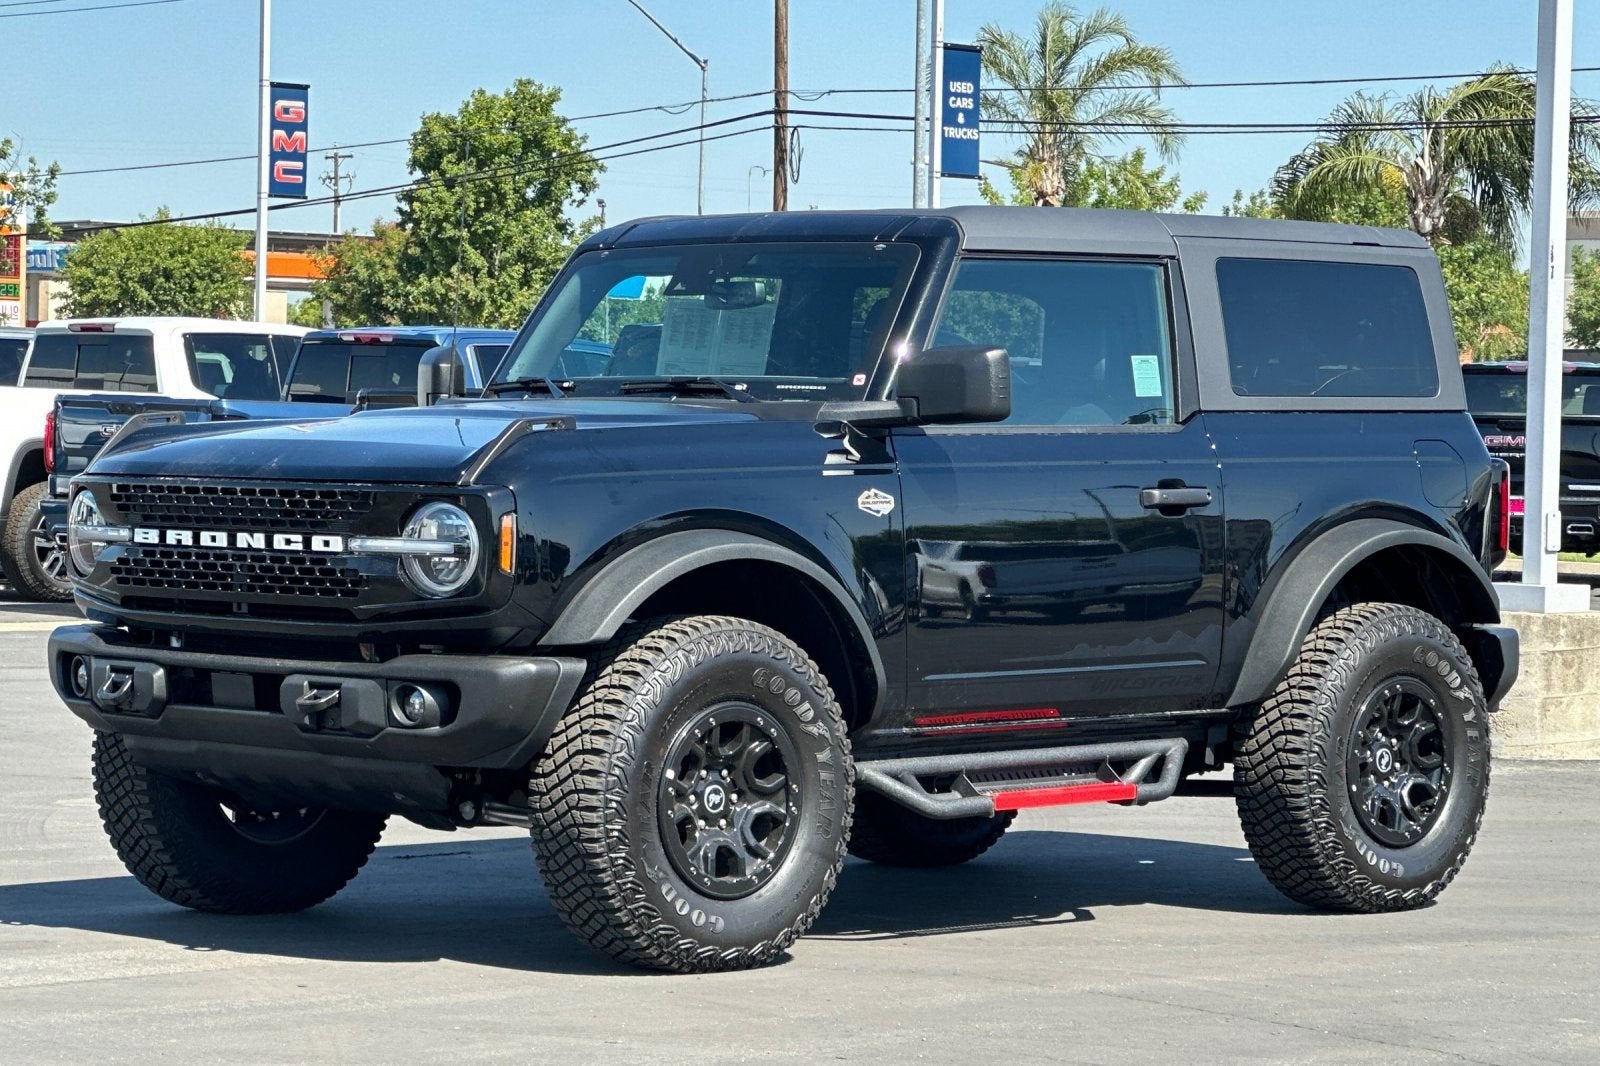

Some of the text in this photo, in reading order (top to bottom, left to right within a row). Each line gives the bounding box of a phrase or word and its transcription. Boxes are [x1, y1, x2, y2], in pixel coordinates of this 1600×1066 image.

[949, 81, 974, 93] USED
[948, 96, 974, 109] CARS
[957, 112, 965, 124] &
[943, 126, 979, 140] TRUCKS
[272, 99, 306, 183] GMC
[1484, 435, 1527, 447] GM
[133, 527, 344, 553] BRONCO
